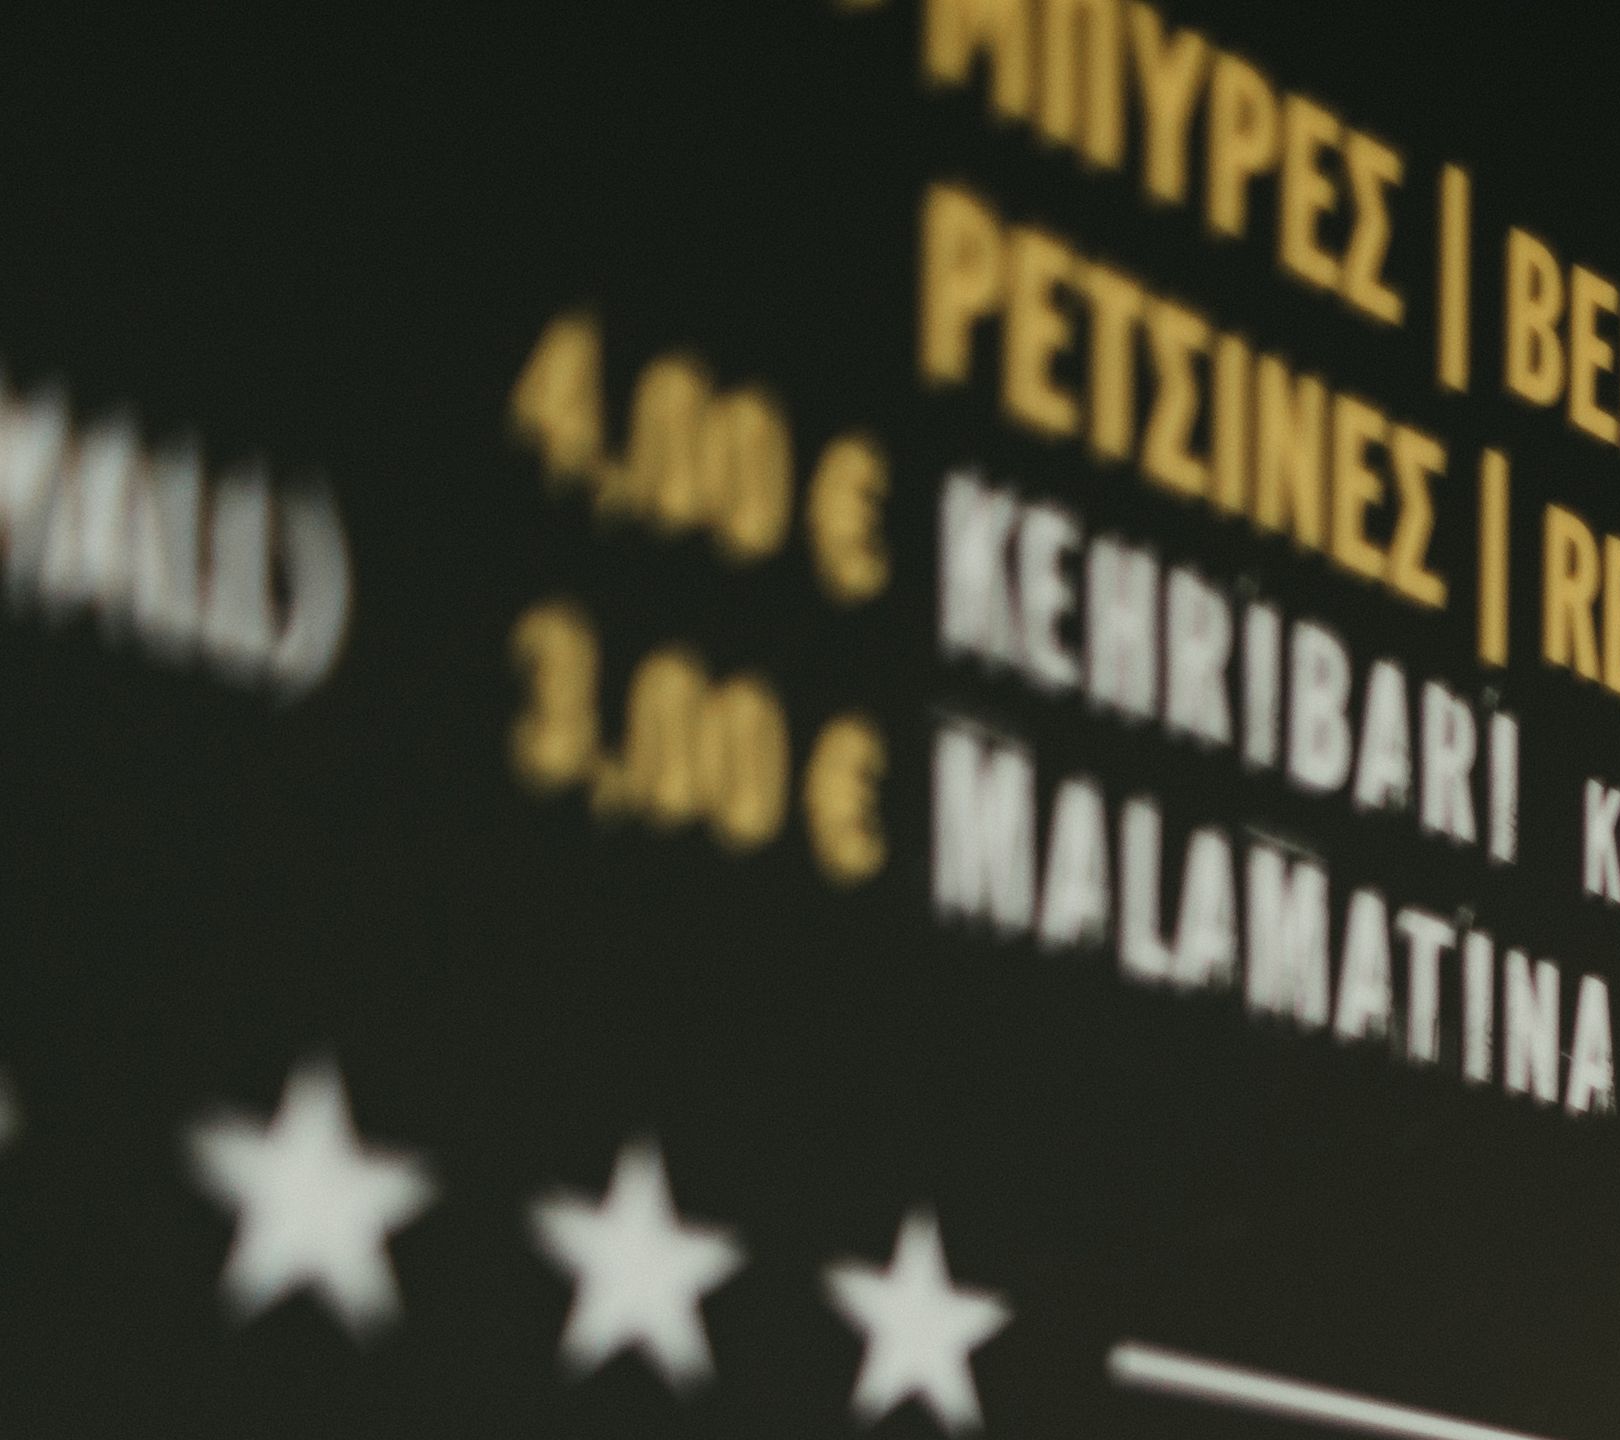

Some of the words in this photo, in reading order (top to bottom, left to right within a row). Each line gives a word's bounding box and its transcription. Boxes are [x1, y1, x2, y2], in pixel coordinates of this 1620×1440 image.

[810, 434, 889, 598] €
[921, 185, 1447, 609] ΡΕΤΣΙΝΕΣ
[808, 718, 887, 882] €
[941, 468, 1520, 866] KEHRIBARI
[932, 718, 1618, 1117] MALAMATINA
